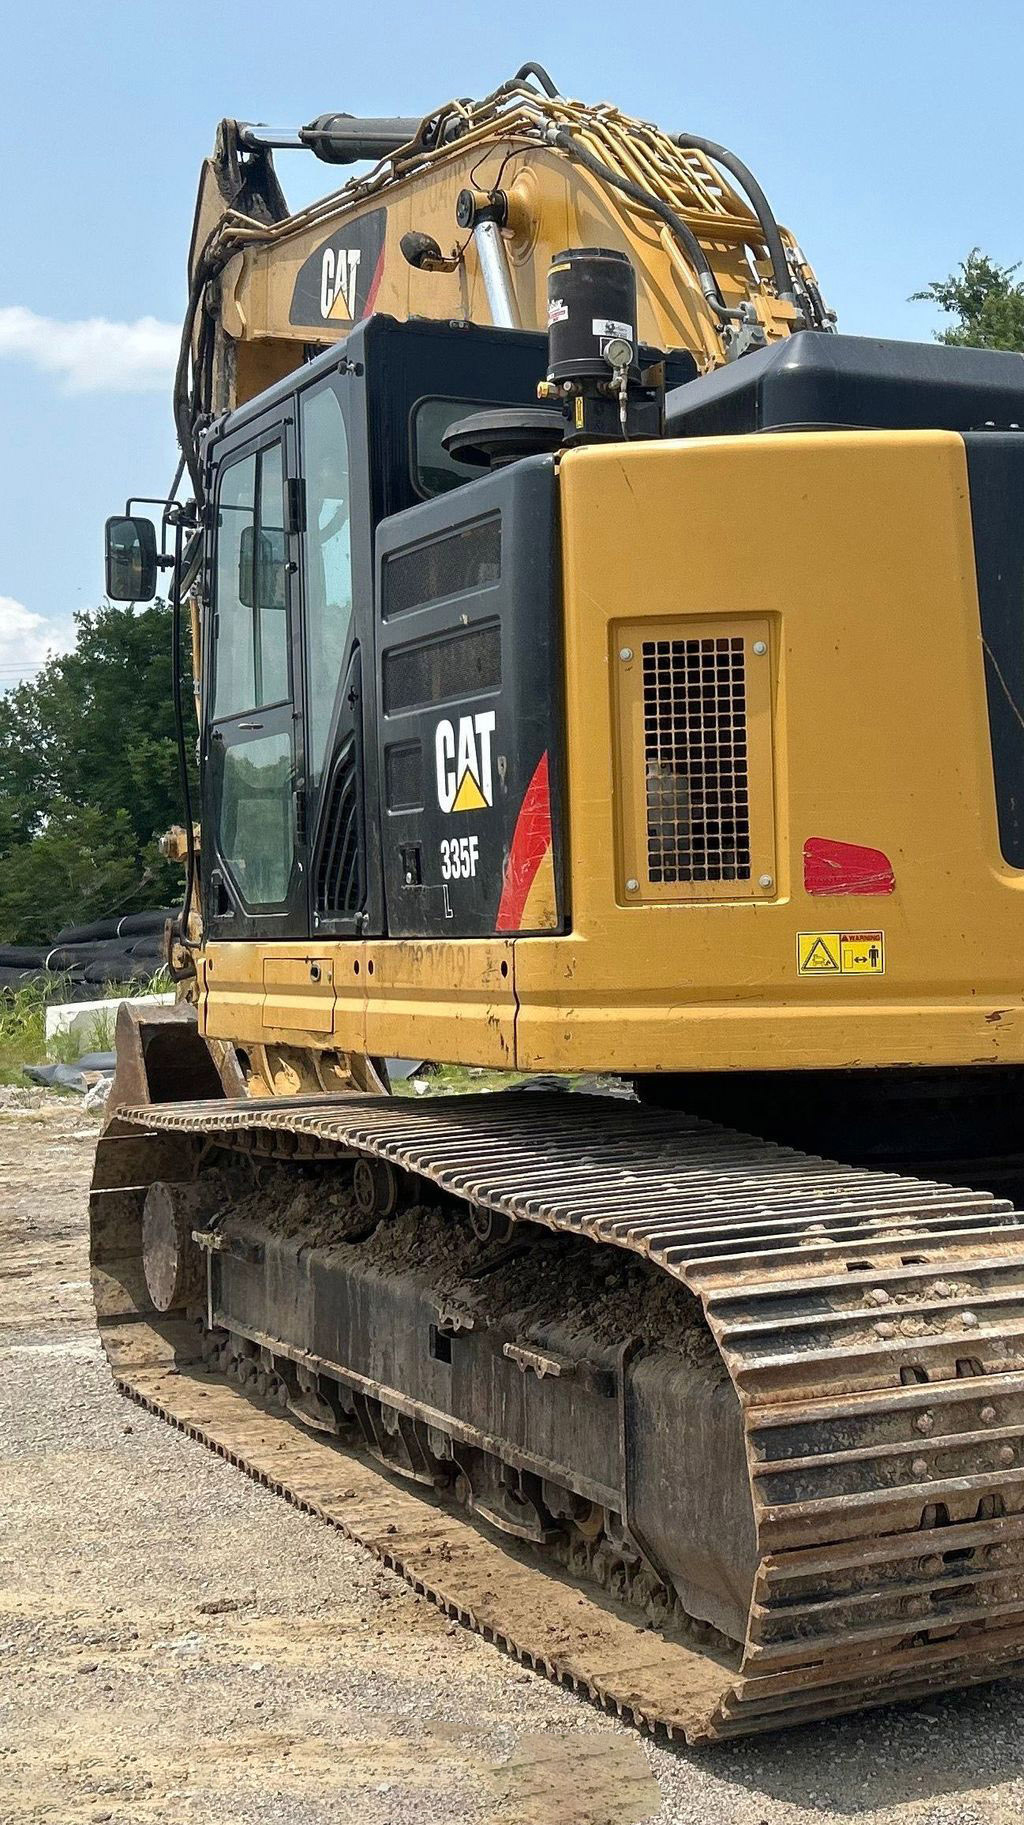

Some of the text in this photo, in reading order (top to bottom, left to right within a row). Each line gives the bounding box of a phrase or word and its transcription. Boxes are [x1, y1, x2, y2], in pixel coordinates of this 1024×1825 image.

[321, 248, 361, 320] CAT
[435, 710, 496, 814] CAT
[440, 835, 479, 880] 335F
[443, 884, 454, 919] L
